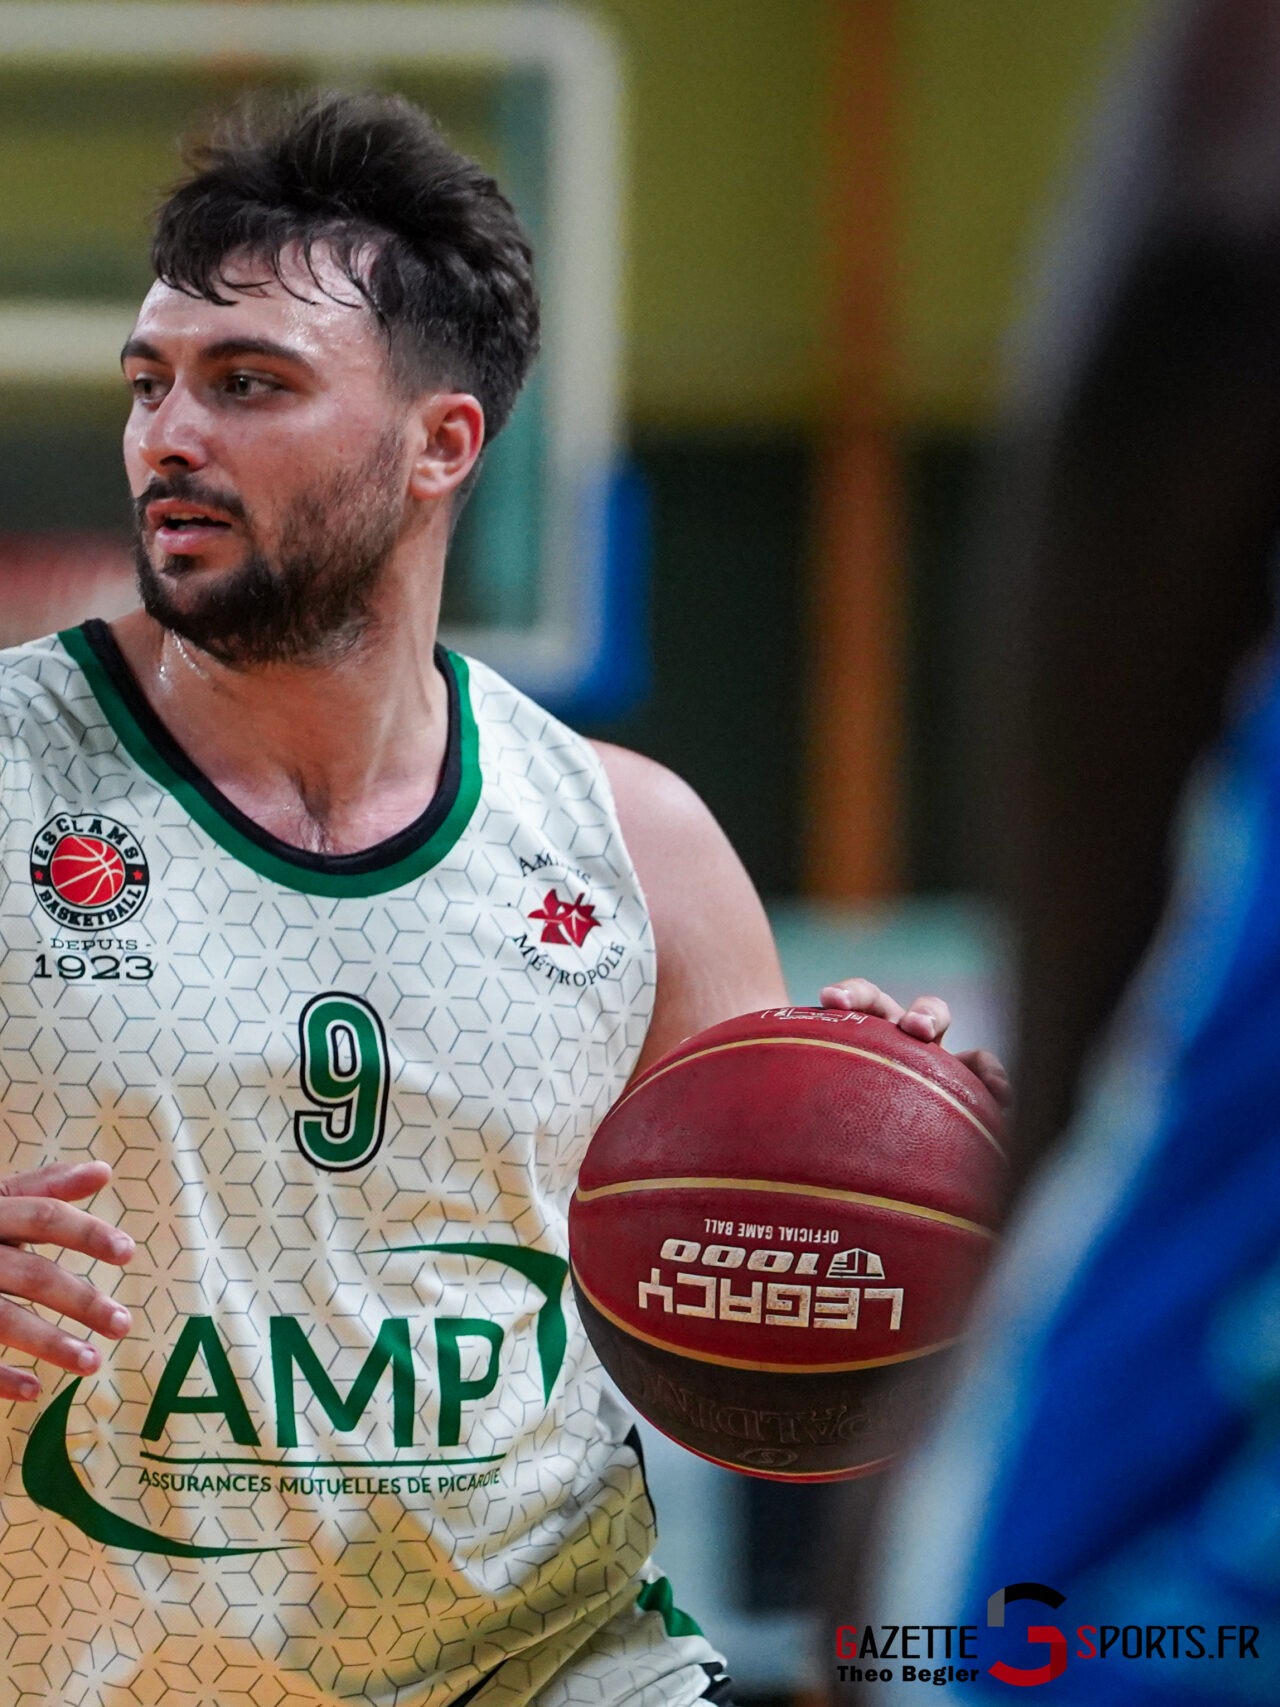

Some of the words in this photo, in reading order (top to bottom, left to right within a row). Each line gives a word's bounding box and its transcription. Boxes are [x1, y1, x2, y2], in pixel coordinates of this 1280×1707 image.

[38, 888, 142, 928] BASKETBALL
[50, 937, 139, 951] DEPUIS
[34, 954, 154, 980] 1923
[294, 991, 391, 1173] 9
[704, 1218, 733, 1237] BALL
[738, 1222, 773, 1240] GAME
[779, 1226, 839, 1244] OFFICIAL
[660, 1238, 820, 1275] 1000
[638, 1268, 904, 1330] LEGACY
[140, 1315, 505, 1448] AMP
[138, 1468, 271, 1493] ASSURANCES
[279, 1477, 402, 1496] MUTUELLES
[407, 1477, 432, 1494] DE
[438, 1467, 501, 1493] PICARDIE
